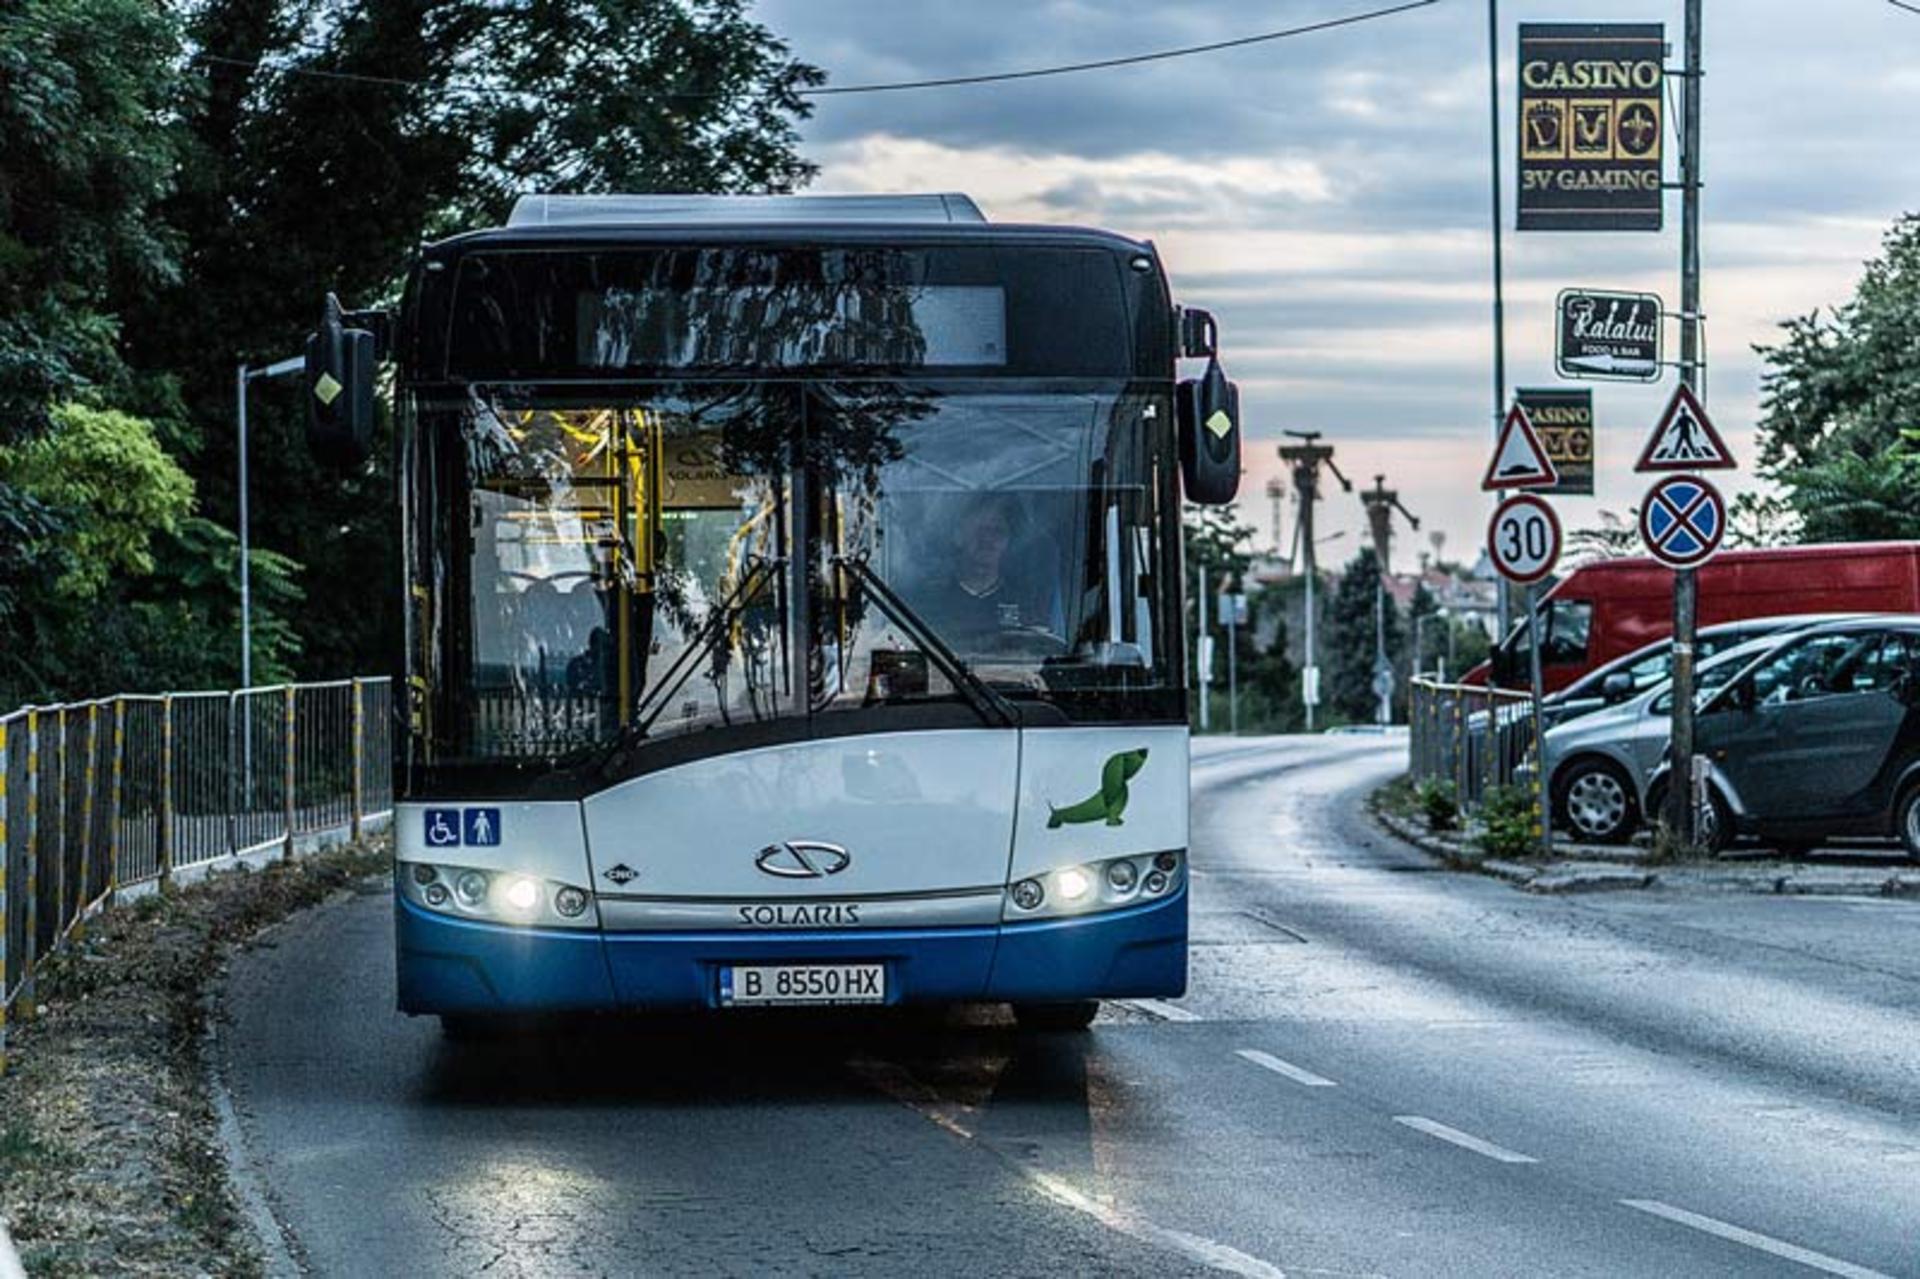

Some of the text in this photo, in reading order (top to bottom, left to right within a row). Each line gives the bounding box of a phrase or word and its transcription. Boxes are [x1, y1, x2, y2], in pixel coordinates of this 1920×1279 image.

[1523, 60, 1661, 89] CASINO
[1523, 169, 1660, 191] 3V GAMING
[1567, 297, 1656, 342] Ratatui
[1502, 515, 1547, 564] 30
[738, 904, 860, 925] SOLARIS
[745, 971, 762, 997] B
[776, 970, 840, 996] 8550
[844, 968, 880, 995] HX
